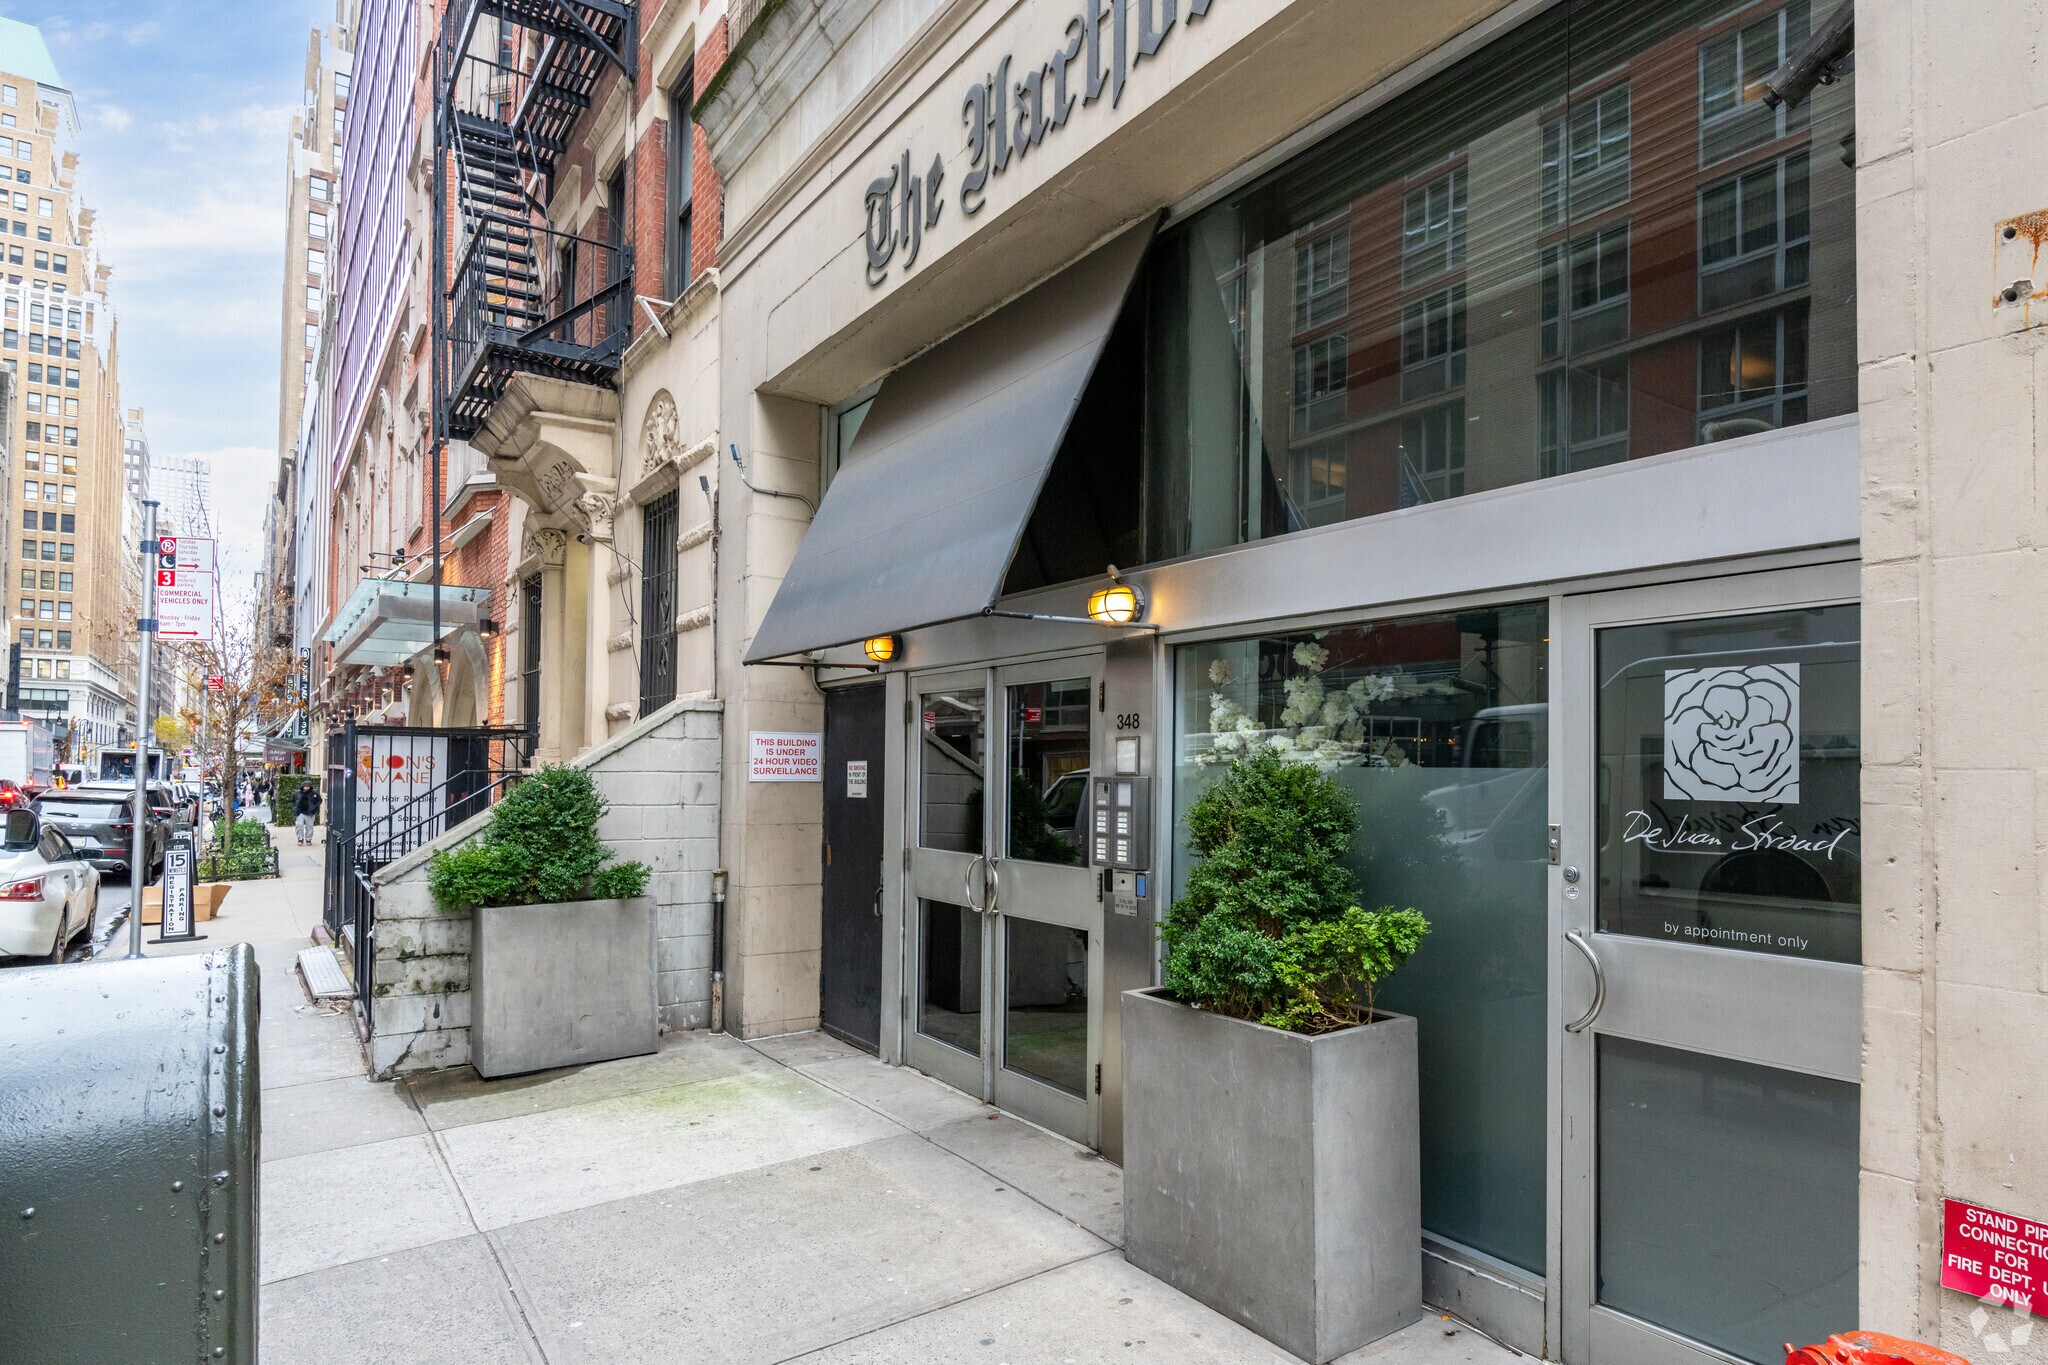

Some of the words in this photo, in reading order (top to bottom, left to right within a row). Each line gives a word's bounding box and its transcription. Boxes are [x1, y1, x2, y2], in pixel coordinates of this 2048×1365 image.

[865, 149, 944, 286] The
[960, 0, 1213, 215] Hartfo
[162, 572, 171, 585] 3
[1117, 713, 1140, 730] 348
[777, 739, 816, 747] BUILDING
[372, 755, 436, 769] LION'S
[792, 758, 818, 766] VIDEO
[374, 772, 430, 784] MANE
[1732, 814, 1850, 860] Stroud
[170, 854, 185, 866] 15
[1664, 921, 1679, 934] by
[1684, 923, 1772, 945] appointment
[1778, 935, 1808, 950] only
[1966, 1208, 2018, 1233] STAND
[2024, 1224, 2048, 1241] PIP
[1994, 1250, 2028, 1271] FOR
[1948, 1254, 1982, 1275] FIRE
[1990, 1266, 2036, 1292] DEPT.
[1990, 1284, 2032, 1306] ONLY
